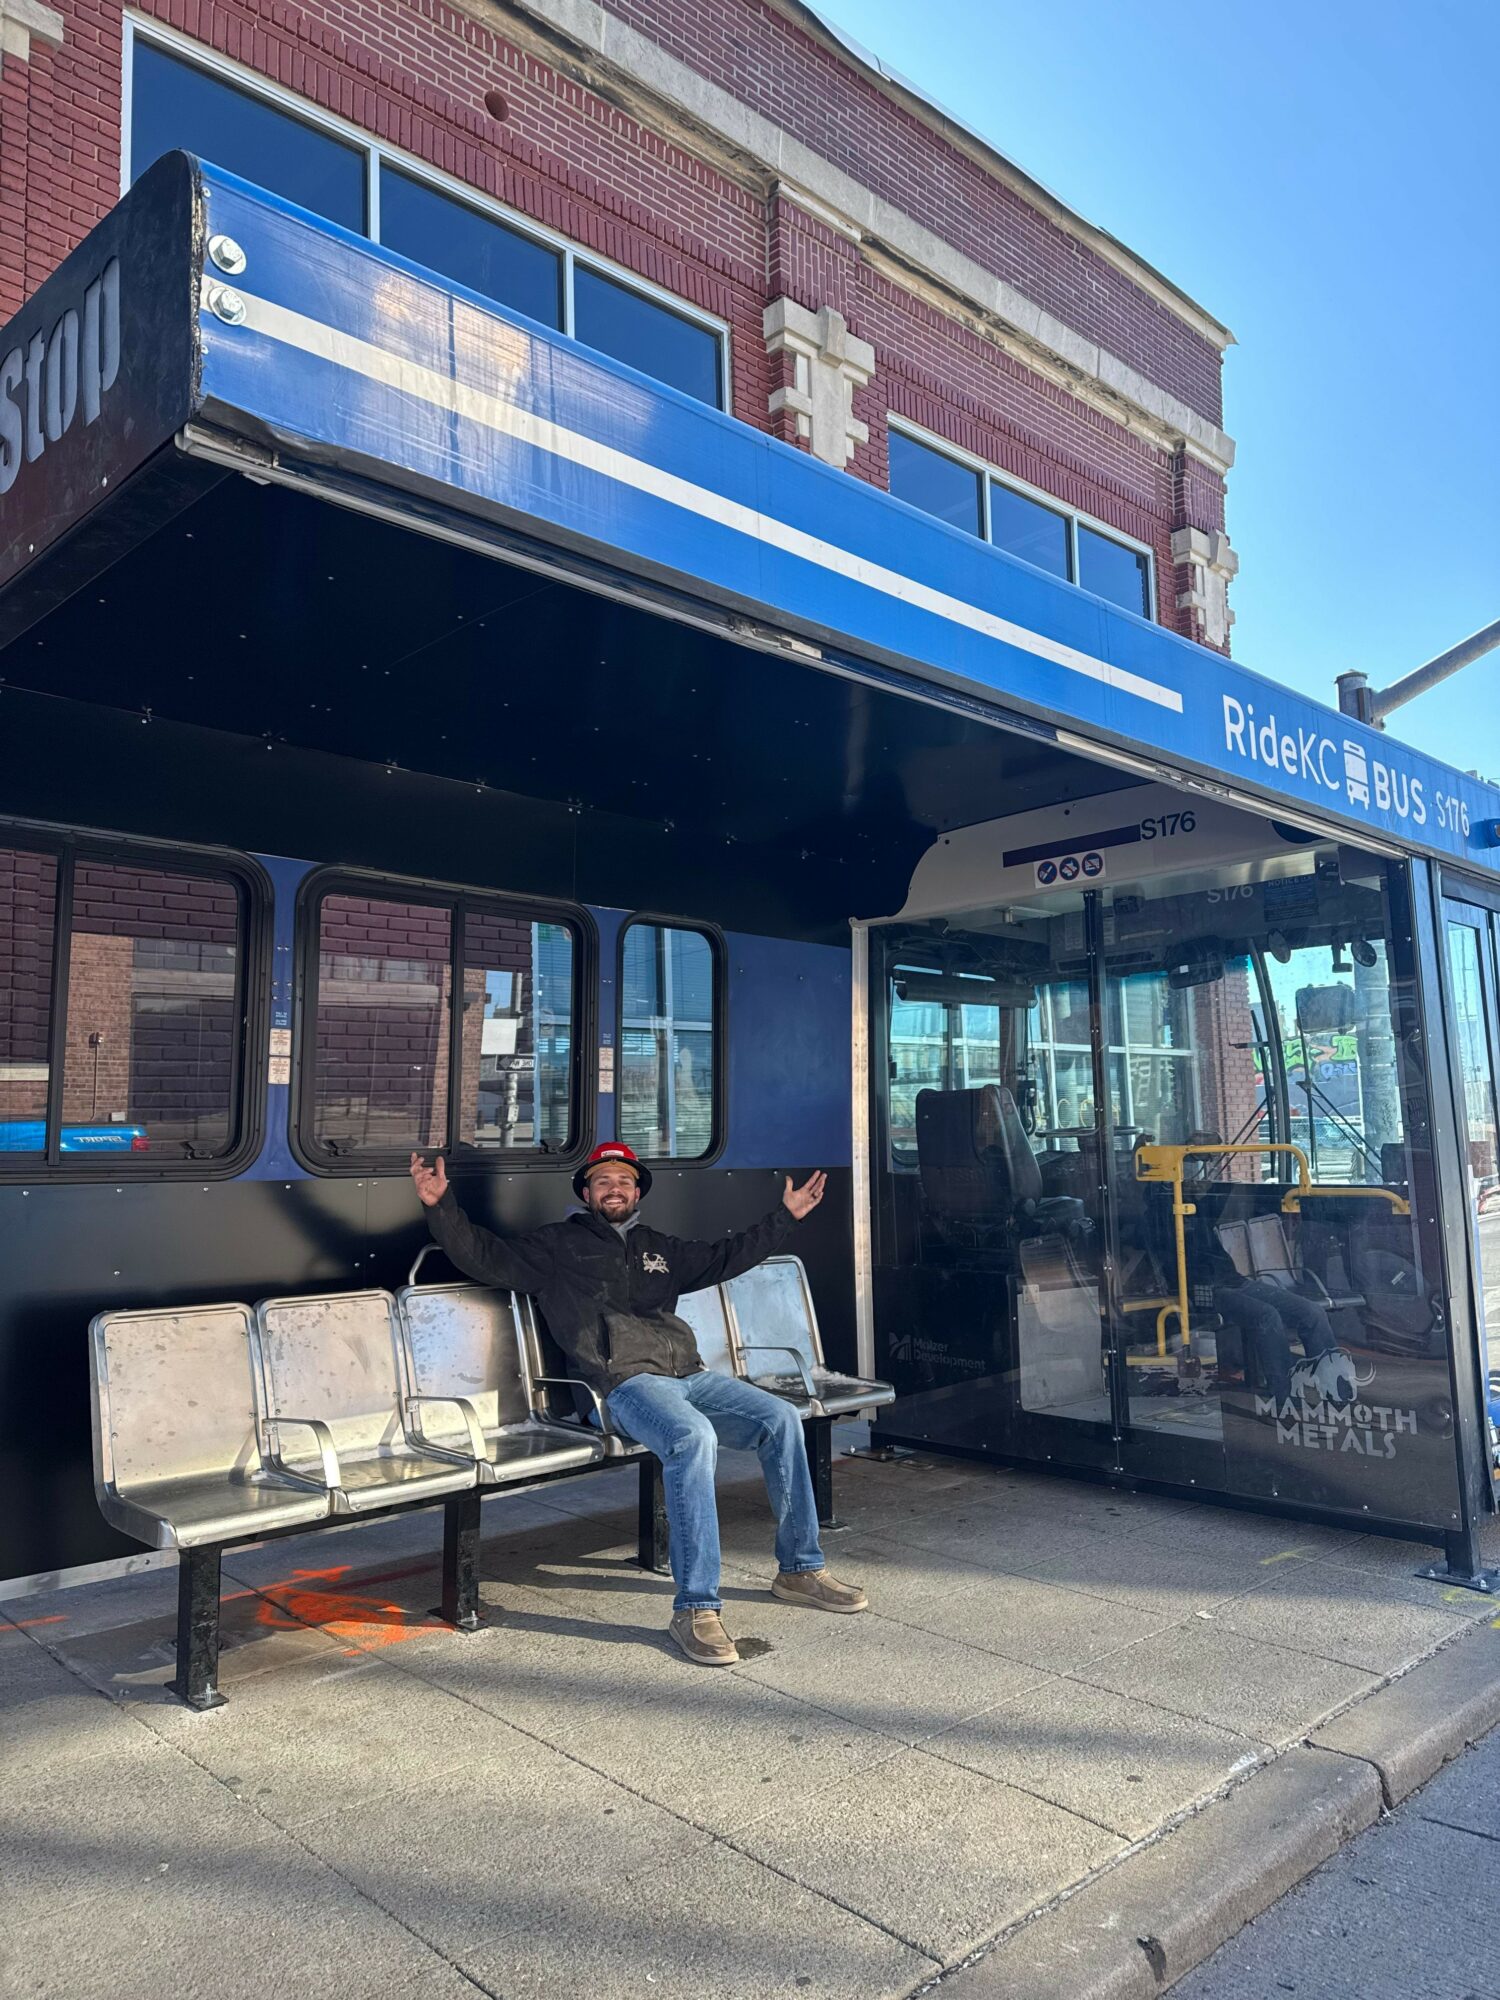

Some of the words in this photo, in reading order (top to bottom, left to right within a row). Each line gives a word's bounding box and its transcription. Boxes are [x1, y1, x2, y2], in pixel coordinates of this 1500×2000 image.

[1222, 694, 1340, 791] RideKC
[1373, 760, 1427, 825] BUS
[1435, 790, 1471, 837] S176
[1140, 810, 1196, 840] S176
[1254, 1394, 1418, 1435] MAMMOTH
[1276, 1419, 1397, 1459] METALS
